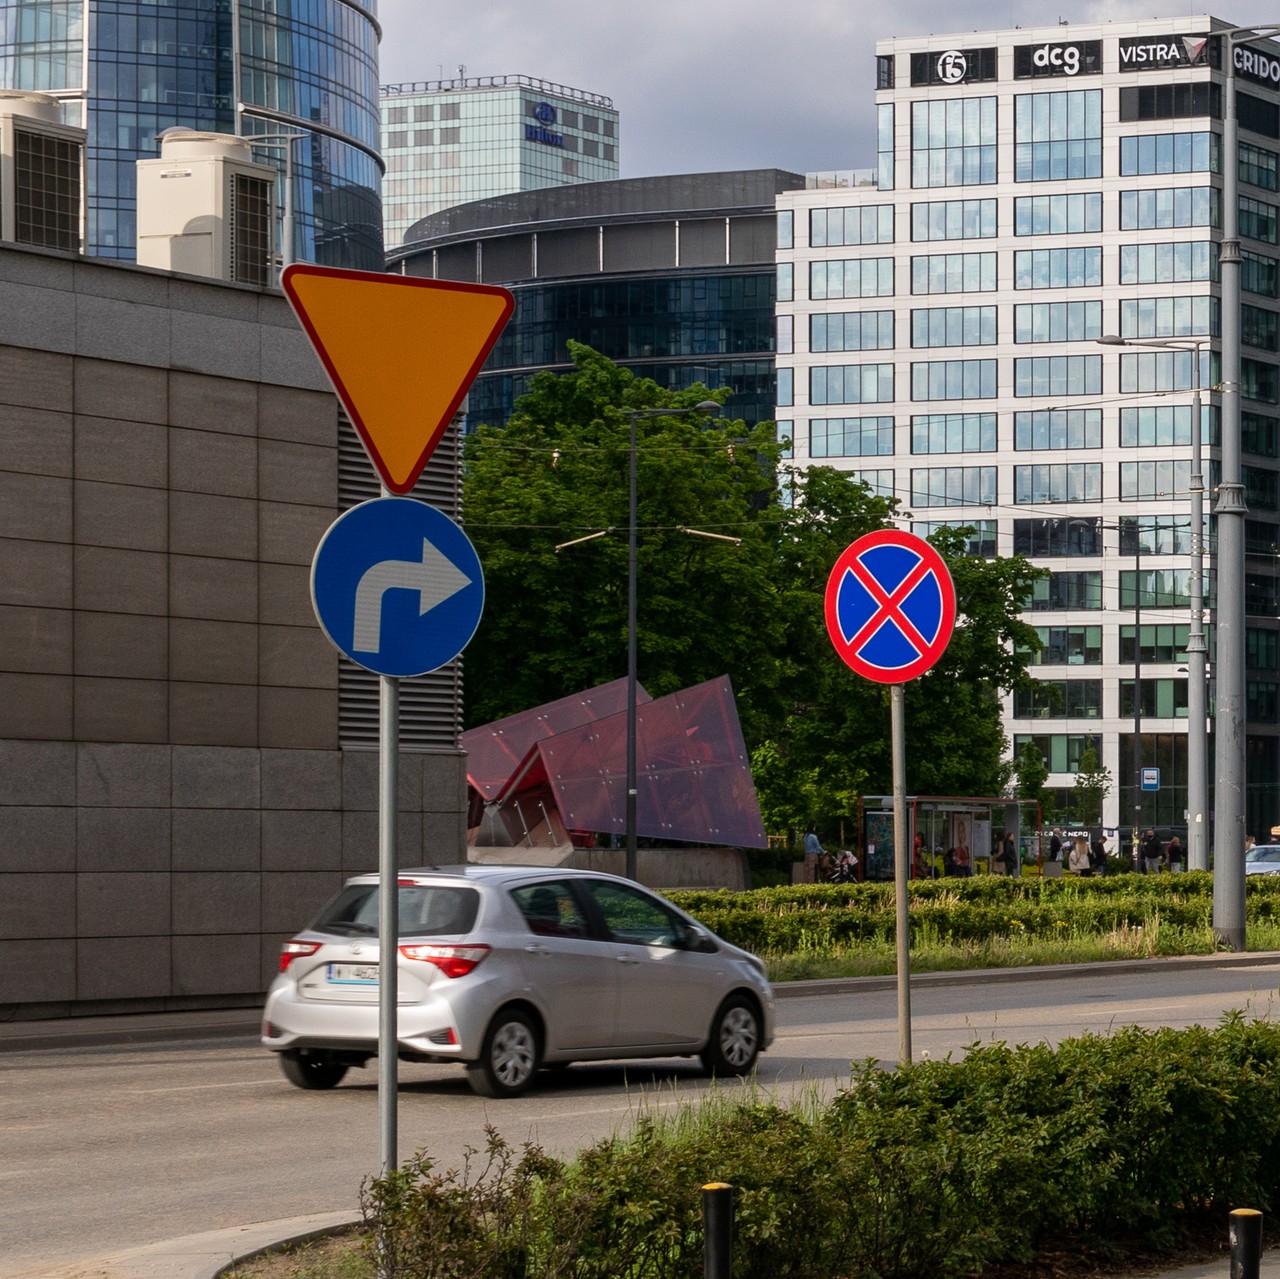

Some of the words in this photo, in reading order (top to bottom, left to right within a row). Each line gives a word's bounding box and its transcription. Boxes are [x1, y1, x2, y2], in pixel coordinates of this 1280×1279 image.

[939, 53, 966, 80] f5
[1033, 43, 1080, 76] dcg
[1119, 43, 1181, 63] VISTRA
[1233, 47, 1280, 82] CRIDO
